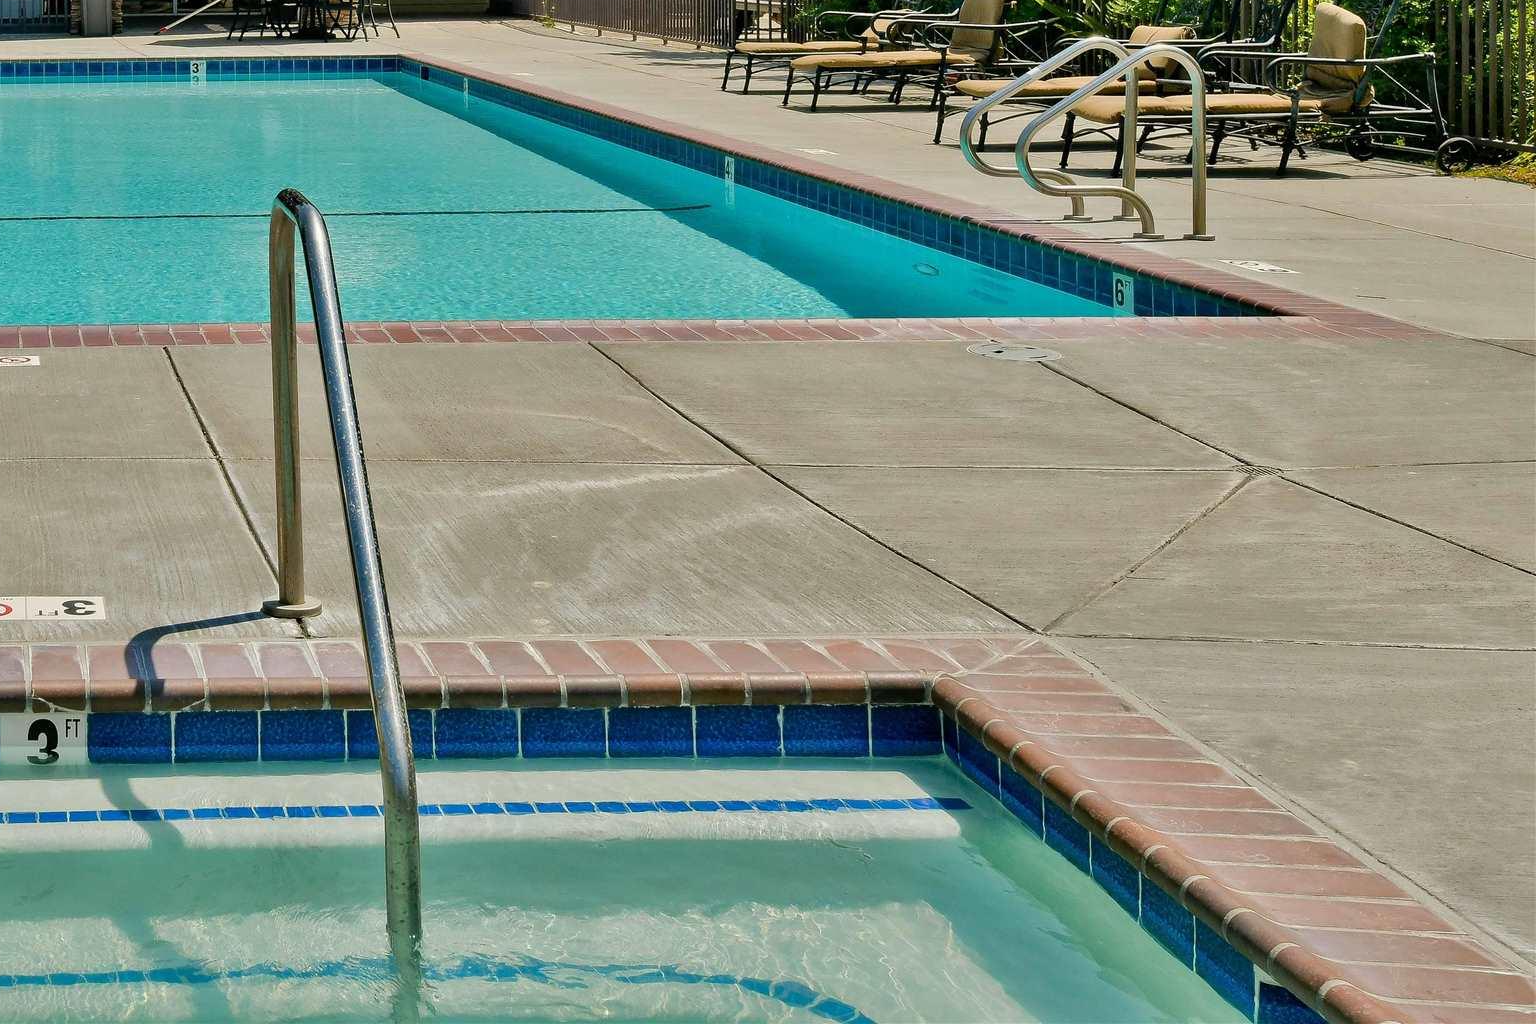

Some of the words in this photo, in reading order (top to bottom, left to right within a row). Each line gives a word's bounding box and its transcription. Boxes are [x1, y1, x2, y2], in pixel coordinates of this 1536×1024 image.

[192, 63, 199, 73] 3
[1115, 278, 1124, 306] 6
[62, 600, 96, 616] 3
[27, 719, 59, 764] 3
[65, 719, 80, 738] FT
